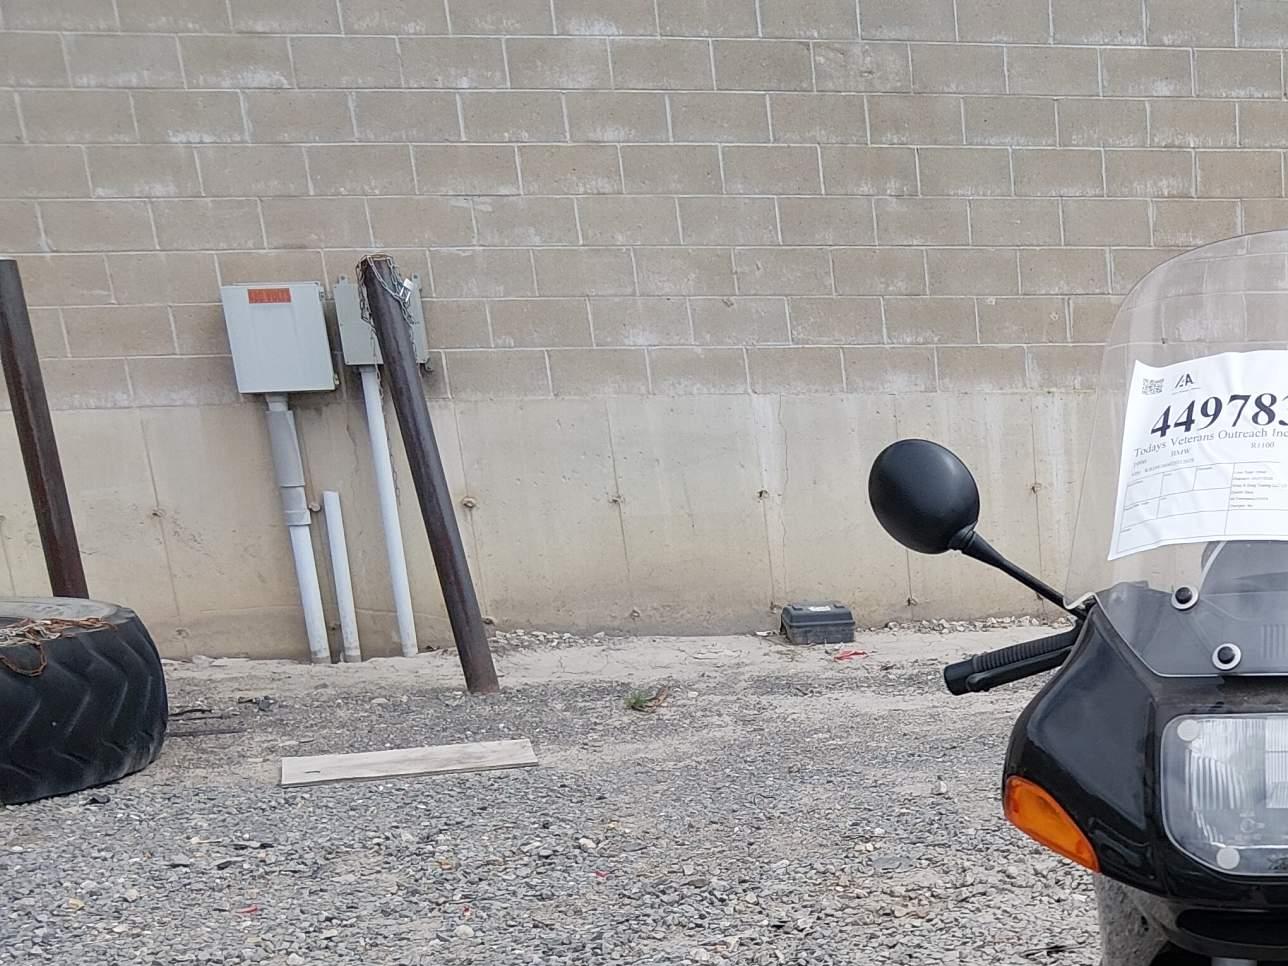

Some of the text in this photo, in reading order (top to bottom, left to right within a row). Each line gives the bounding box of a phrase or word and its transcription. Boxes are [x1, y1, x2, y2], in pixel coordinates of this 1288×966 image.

[1133, 428, 1288, 458] Todays Veterans Outreach Inc
